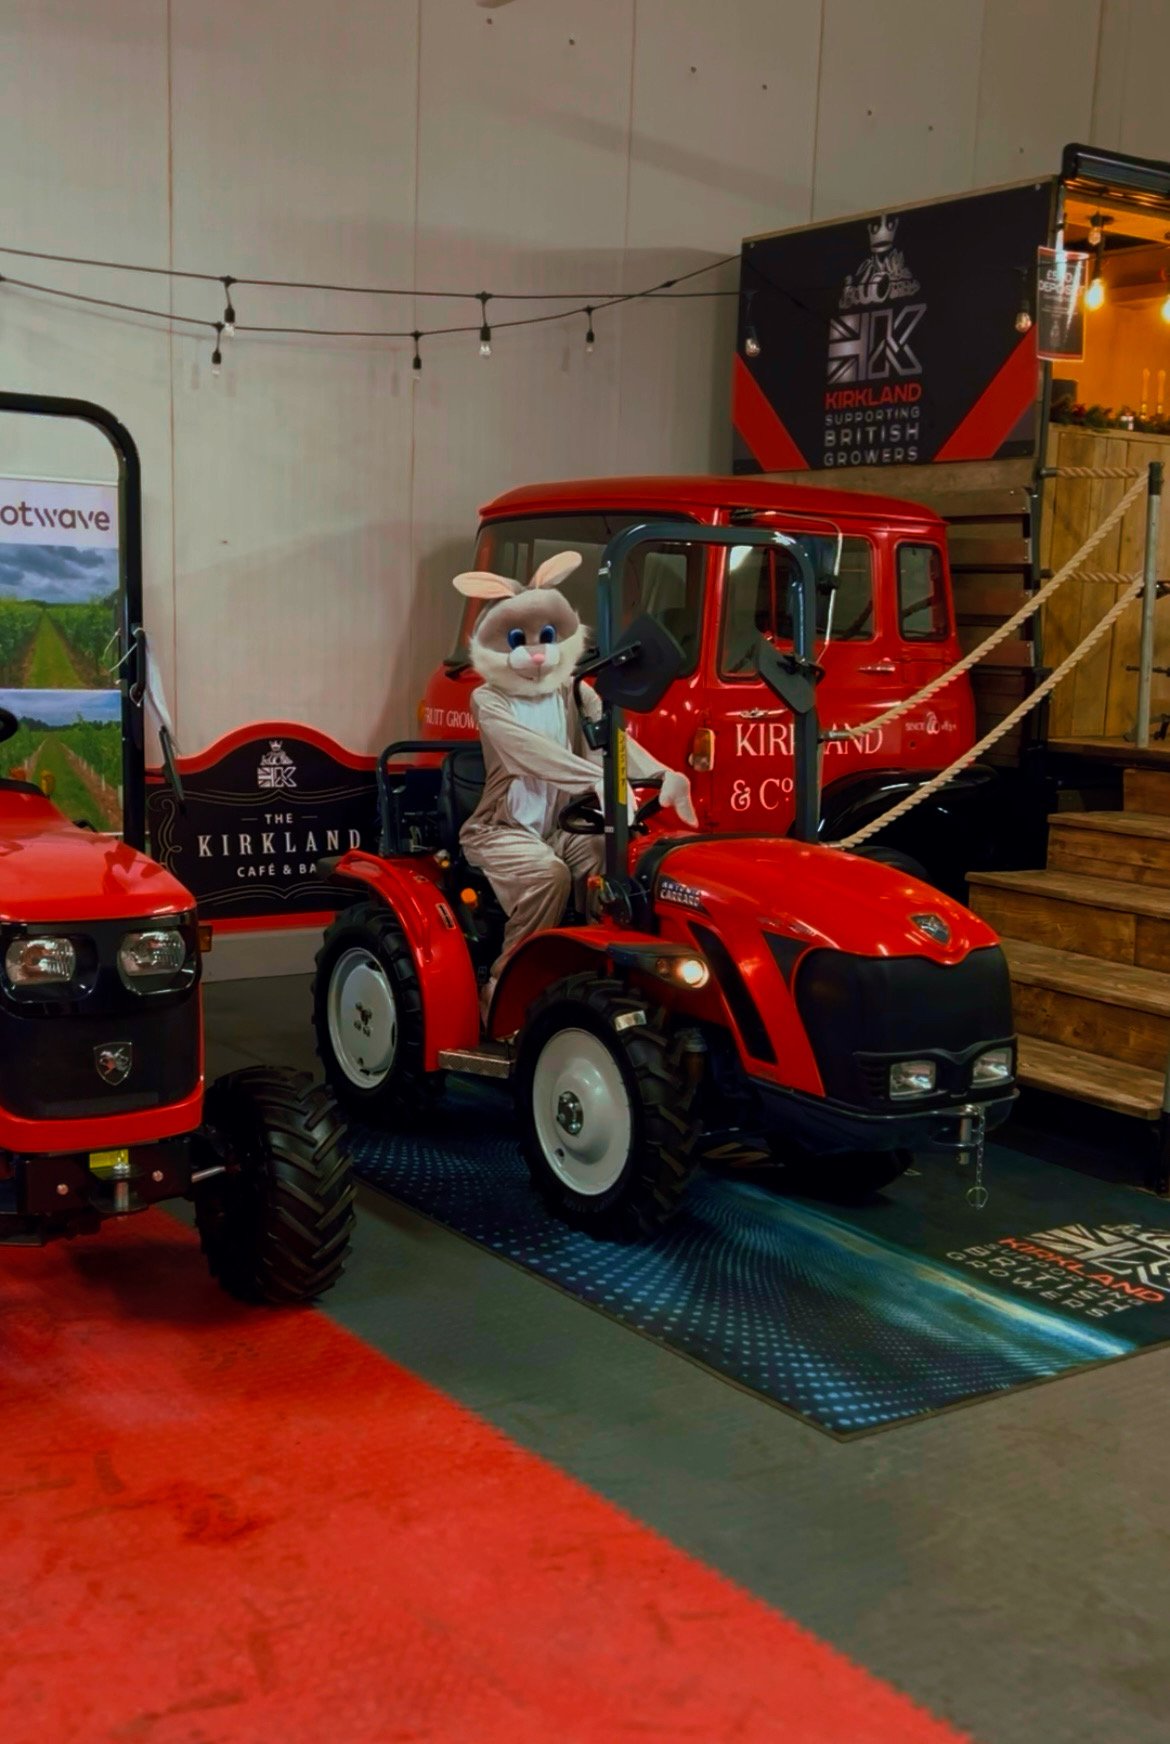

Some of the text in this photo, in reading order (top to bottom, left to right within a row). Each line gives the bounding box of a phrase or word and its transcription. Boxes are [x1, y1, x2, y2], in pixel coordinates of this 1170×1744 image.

[824, 383, 922, 410] KIRKLAND
[825, 406, 920, 426] SUPPORTING
[824, 422, 920, 447] BRITISH
[824, 446, 918, 466] GROWERS
[0, 501, 110, 531] otwave
[446, 710, 479, 731] GROW
[735, 722, 883, 756] KIRAND
[730, 779, 751, 812] &
[264, 813, 294, 825] THE
[198, 828, 362, 857] KIRKLAND
[237, 862, 318, 878] CAFÉ & BA
[965, 1247, 1132, 1312] BRITISH
[984, 1242, 1145, 1307] SUPPORTING
[997, 1236, 1166, 1302] KIRKLAND
[945, 1251, 1109, 1318] GROWERS
